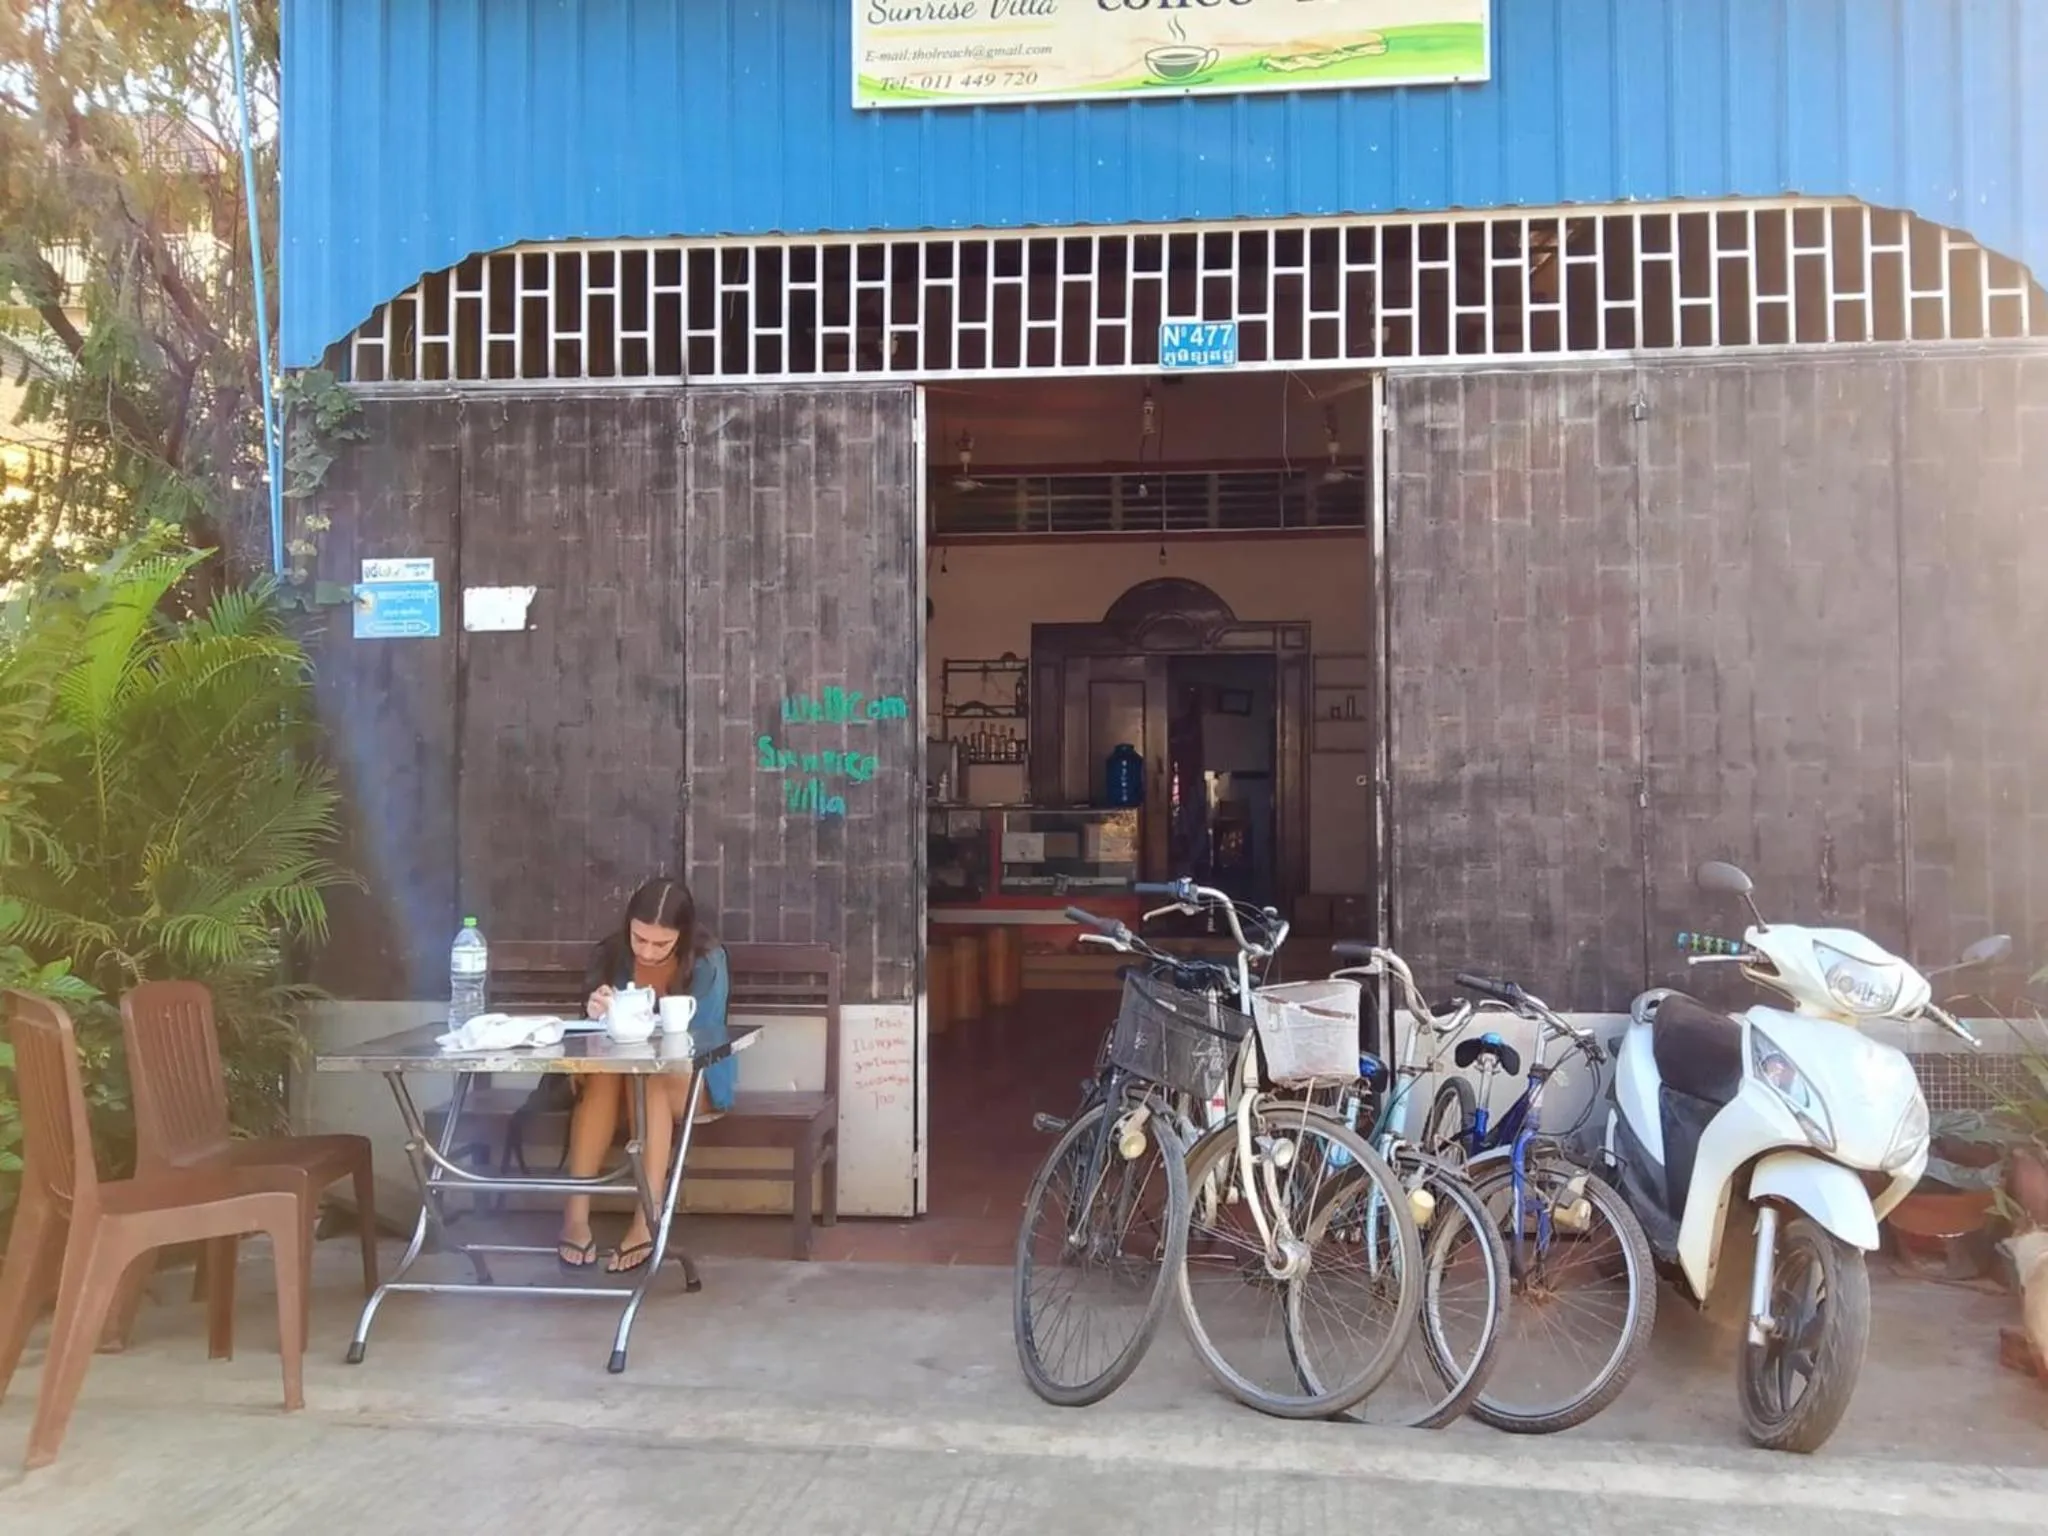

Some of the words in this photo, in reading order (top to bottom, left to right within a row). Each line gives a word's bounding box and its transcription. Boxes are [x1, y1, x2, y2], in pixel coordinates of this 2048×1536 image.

[868, 0, 977, 25] Sunrise
[989, 0, 1057, 19] Villa
[920, 74, 952, 89] 011
[960, 72, 997, 88] 449
[1003, 70, 1038, 87] 720
[1190, 323, 1233, 348] 477
